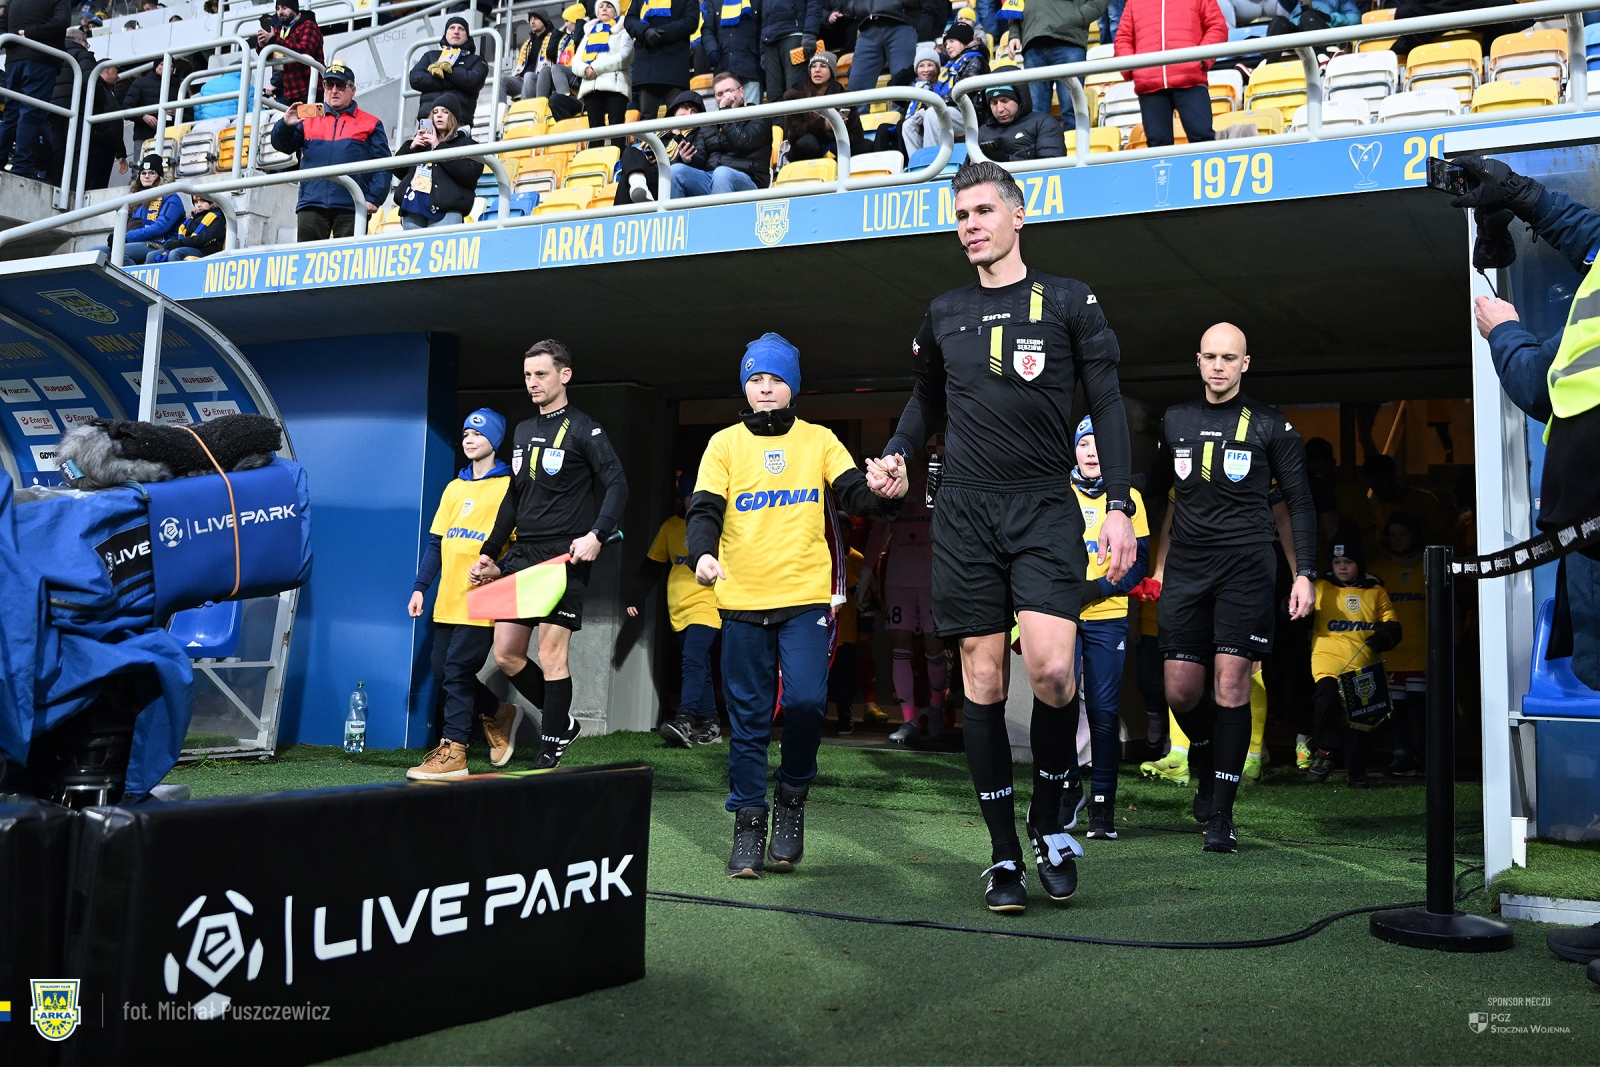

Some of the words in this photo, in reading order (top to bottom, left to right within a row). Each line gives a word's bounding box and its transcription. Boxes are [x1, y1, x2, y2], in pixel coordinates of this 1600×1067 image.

[1192, 152, 1273, 199] 1979
[863, 189, 931, 232] LUDZIE
[542, 223, 604, 262] ARKA
[612, 214, 686, 254] GDYNIA
[204, 258, 261, 293] NIGDY
[265, 254, 299, 287] NIE
[302, 242, 423, 285] ZOSTANIESZ
[429, 236, 481, 273] SAM
[43, 383, 76, 393] SUPERBET
[29, 416, 51, 425] Energa
[162, 410, 185, 418] Energa
[212, 408, 236, 416] Energa
[1227, 451, 1249, 461] FIFA
[735, 488, 819, 512] GDYNIA
[194, 514, 235, 535] LIVE
[239, 503, 297, 526] PARK
[446, 527, 486, 542] GDYNIA
[114, 541, 151, 566] LIVE
[1214, 770, 1240, 782] zina
[980, 786, 1012, 800] zina
[313, 882, 470, 961] LIVE
[484, 854, 634, 926] PARK
